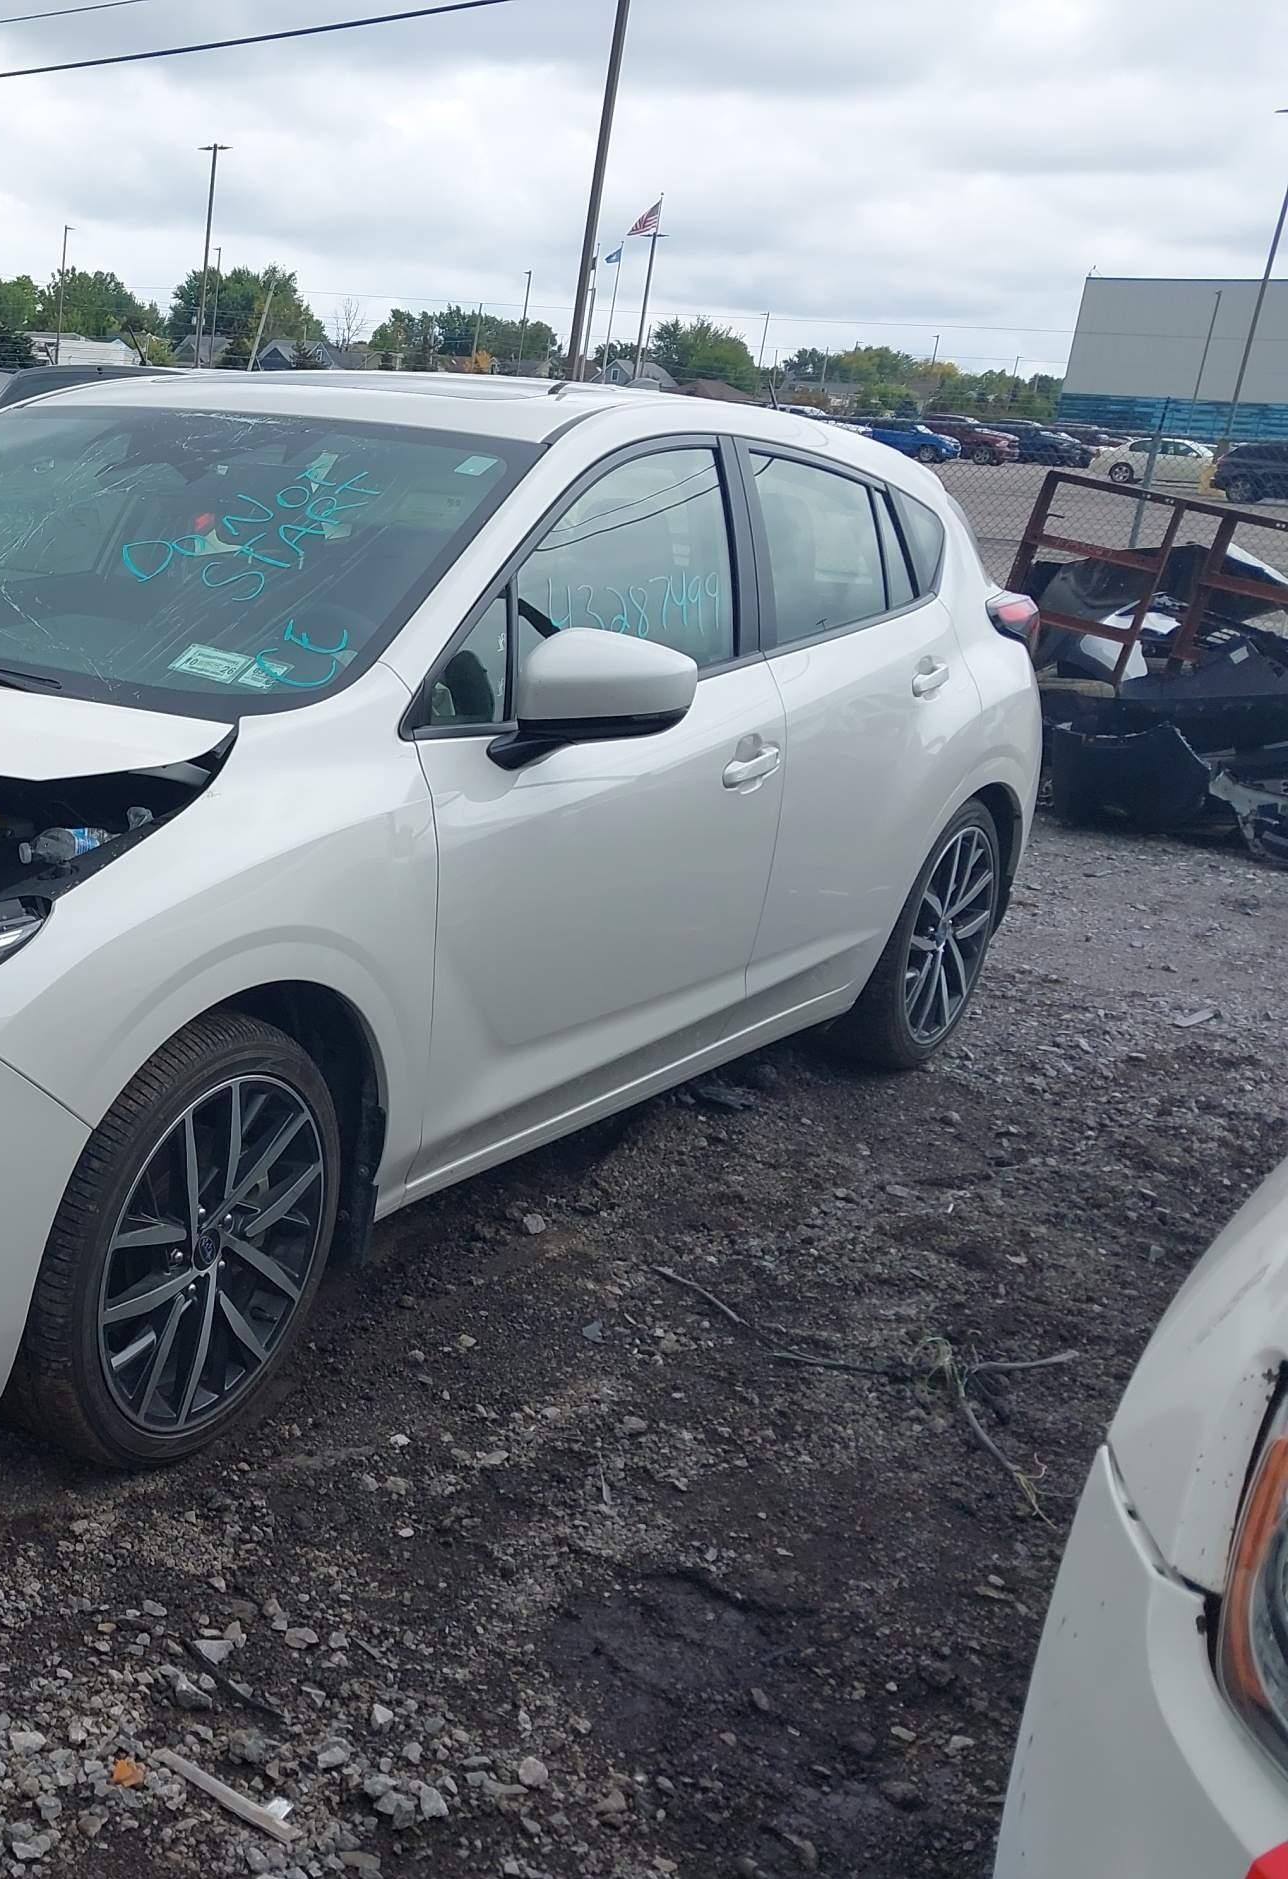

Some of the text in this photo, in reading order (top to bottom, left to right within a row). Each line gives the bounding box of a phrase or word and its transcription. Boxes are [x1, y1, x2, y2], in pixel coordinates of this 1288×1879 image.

[122, 464, 337, 582] DO NOT
[202, 471, 381, 601] START
[546, 569, 720, 638] 43287499
